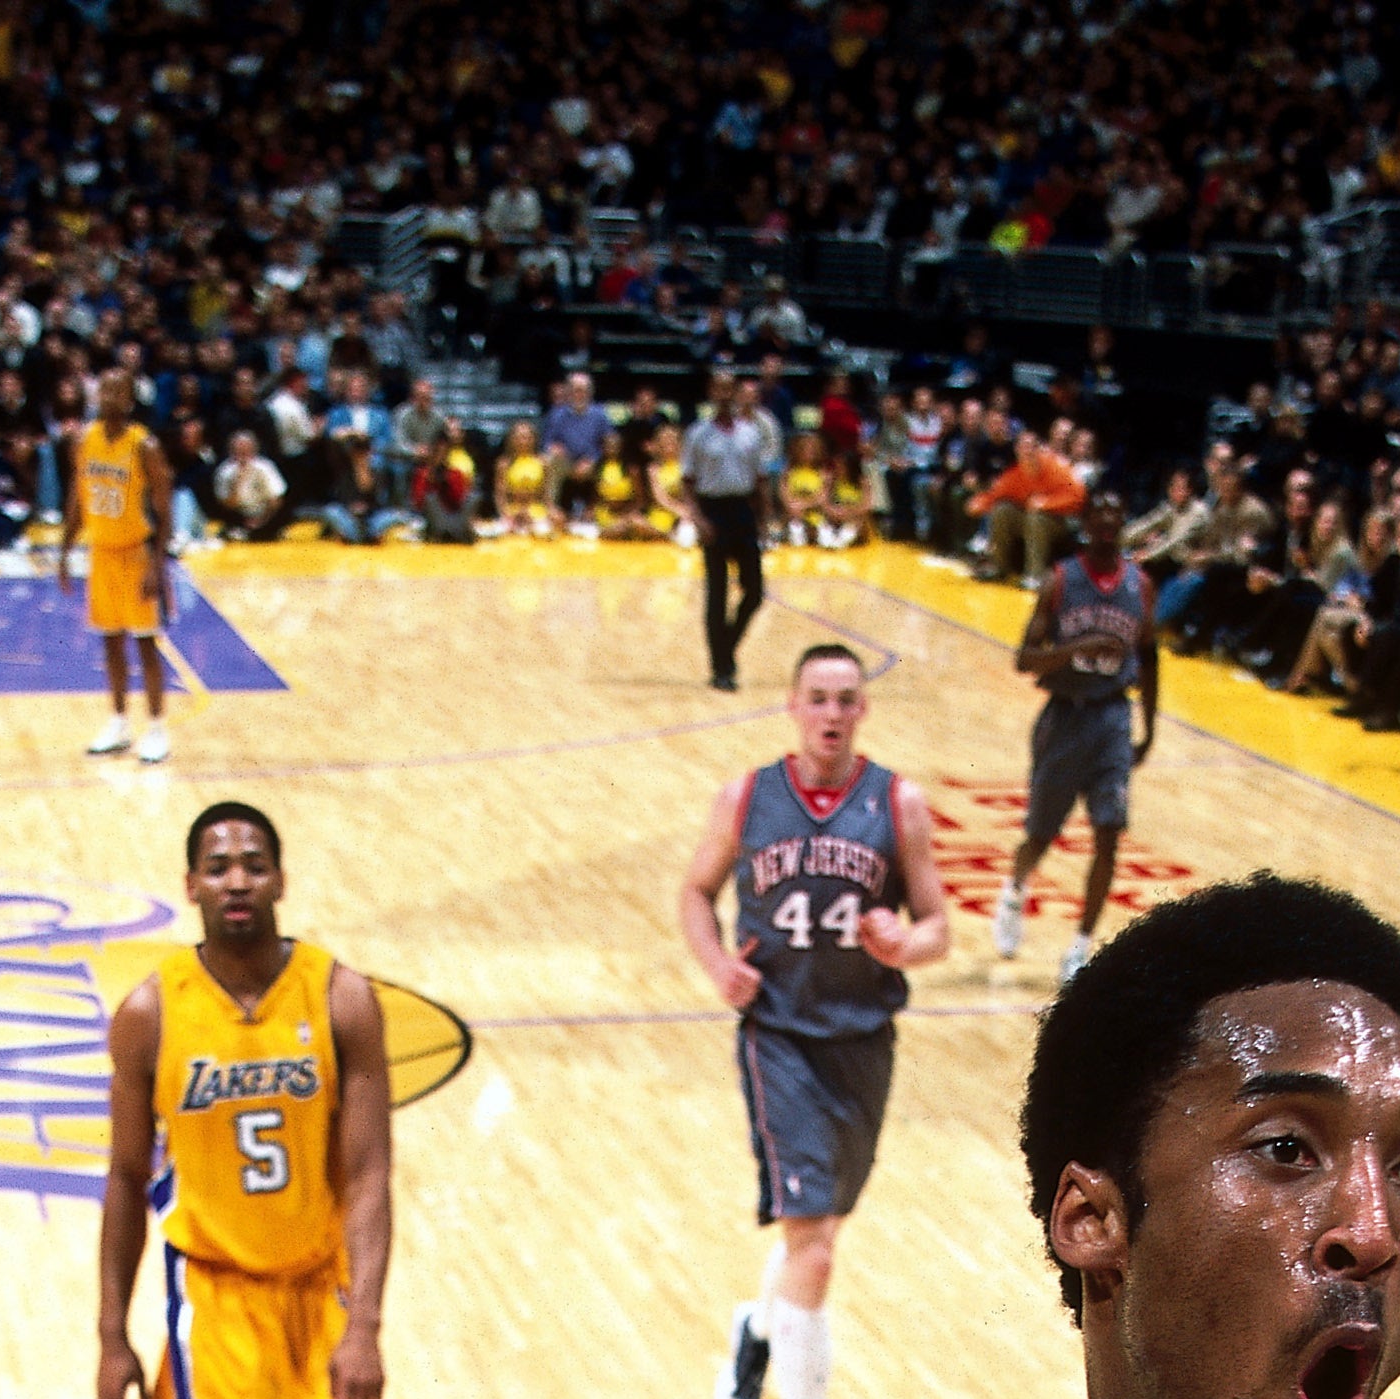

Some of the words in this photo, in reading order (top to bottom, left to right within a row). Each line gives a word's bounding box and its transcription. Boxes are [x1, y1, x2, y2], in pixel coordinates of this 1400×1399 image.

[751, 836, 806, 897] NEW
[772, 890, 863, 949] 44
[178, 1056, 321, 1113] LAKERS
[234, 1108, 291, 1196] 5
